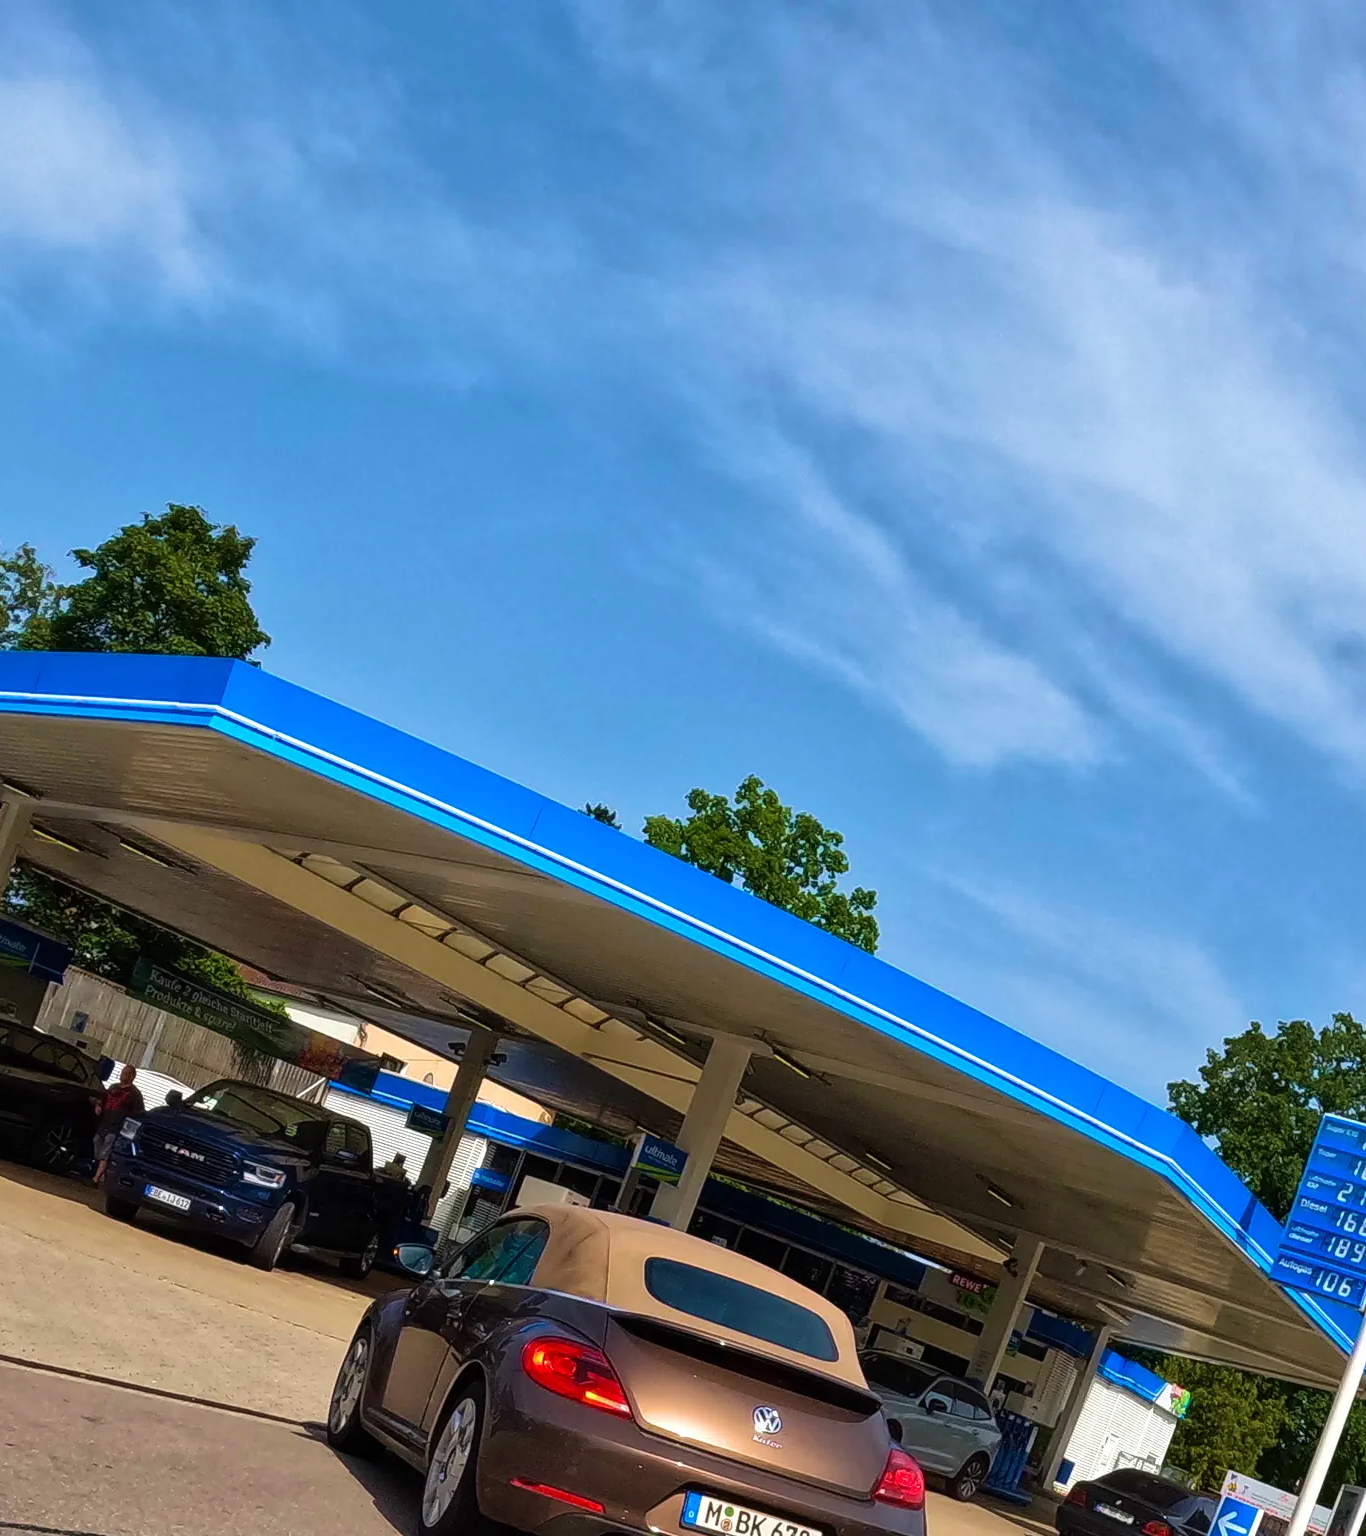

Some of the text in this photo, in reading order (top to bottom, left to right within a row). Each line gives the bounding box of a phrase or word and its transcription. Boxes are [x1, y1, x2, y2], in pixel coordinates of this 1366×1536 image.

[145, 985, 192, 1015] Produkte
[150, 969, 182, 992] Kaufe
[184, 986, 192, 997] 2
[192, 990, 229, 1016] gleiche
[164, 1142, 205, 1162] RAM
[645, 1145, 678, 1165] ultimate
[1300, 1199, 1328, 1214] Diesel
[1278, 1257, 1312, 1275] Autogas
[952, 1275, 982, 1294] REWE
